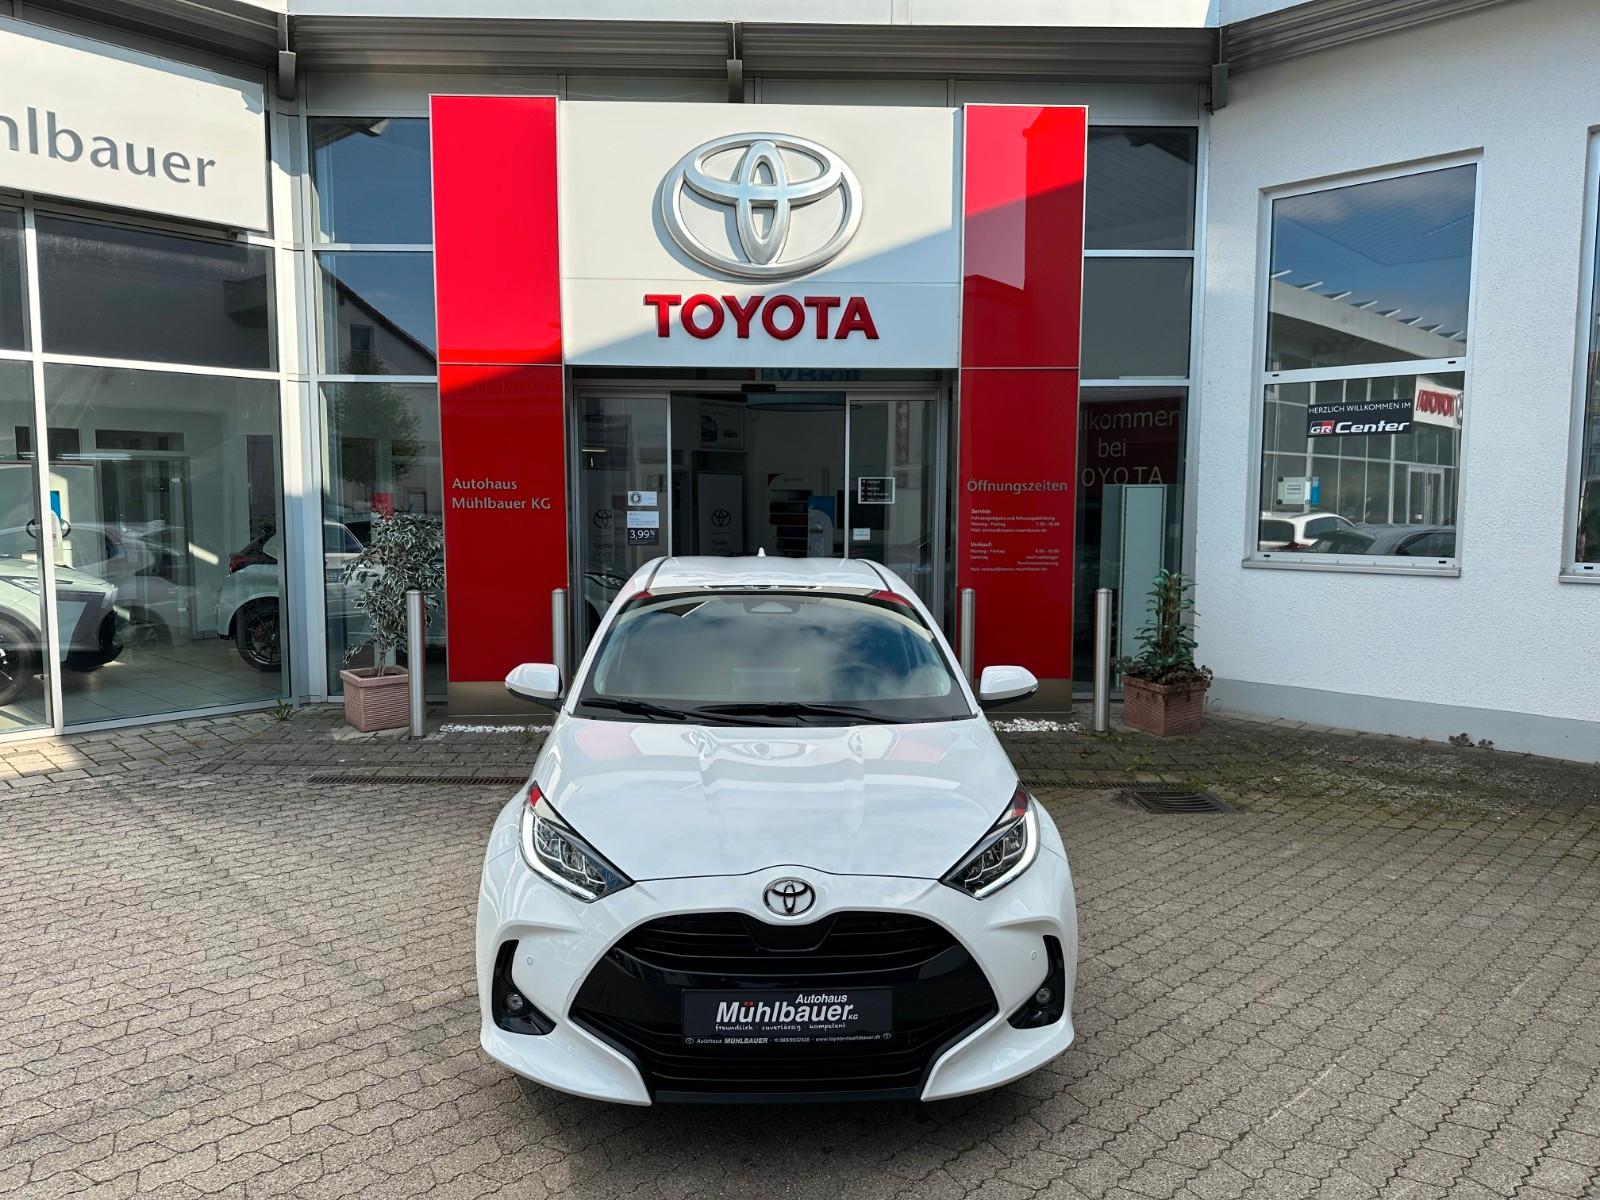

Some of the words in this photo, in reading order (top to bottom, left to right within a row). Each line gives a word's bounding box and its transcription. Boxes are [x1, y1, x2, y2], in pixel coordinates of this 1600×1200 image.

[643, 294, 880, 340] TOYOTA
[1308, 405, 1344, 414] HERZLICH
[1346, 402, 1399, 412] WILLKOMMEN
[1401, 401, 1411, 409] IM
[1310, 425, 1332, 434] GR
[1335, 420, 1410, 434] Center
[1098, 437, 1127, 458] bei
[452, 477, 518, 490] Autohaus
[967, 478, 1068, 495] Öffnungszeiten
[452, 497, 527, 509] Mühlbauer
[531, 497, 551, 510] KG
[795, 994, 848, 1004] Autohaus
[716, 998, 853, 1023] Mühlbauer
[809, 1022, 846, 1031] kompetent
